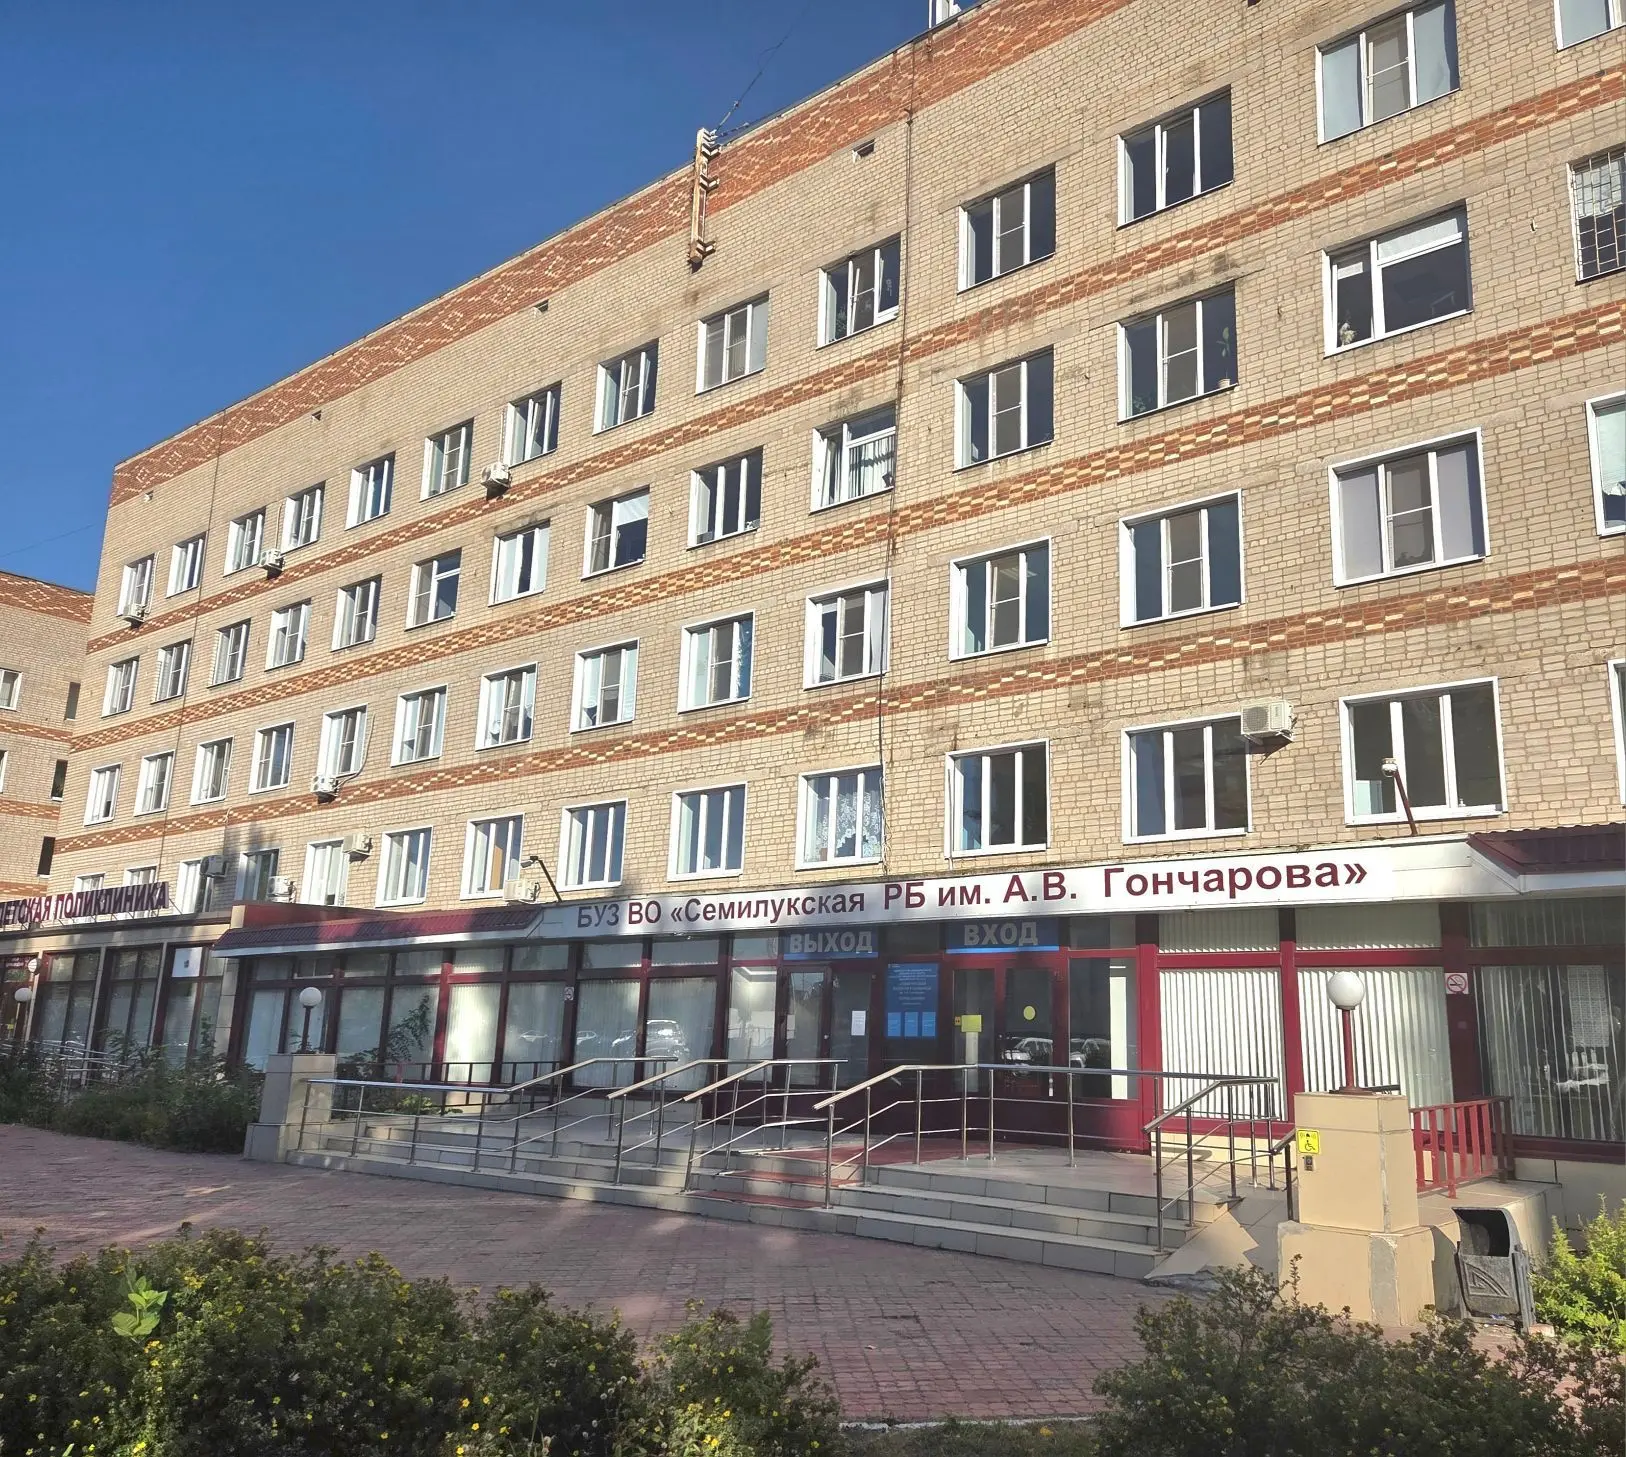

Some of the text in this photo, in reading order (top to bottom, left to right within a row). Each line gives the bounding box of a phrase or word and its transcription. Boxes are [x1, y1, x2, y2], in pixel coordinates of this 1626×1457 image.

[53, 881, 168, 919] ПОЛИКЛИНИКА
[577, 858, 1368, 928] БУЗ ВО «Семилукская РБ им. А.В. Гончарова»
[788, 931, 873, 954] ВЫХОД
[963, 921, 1039, 946] ВХОД
